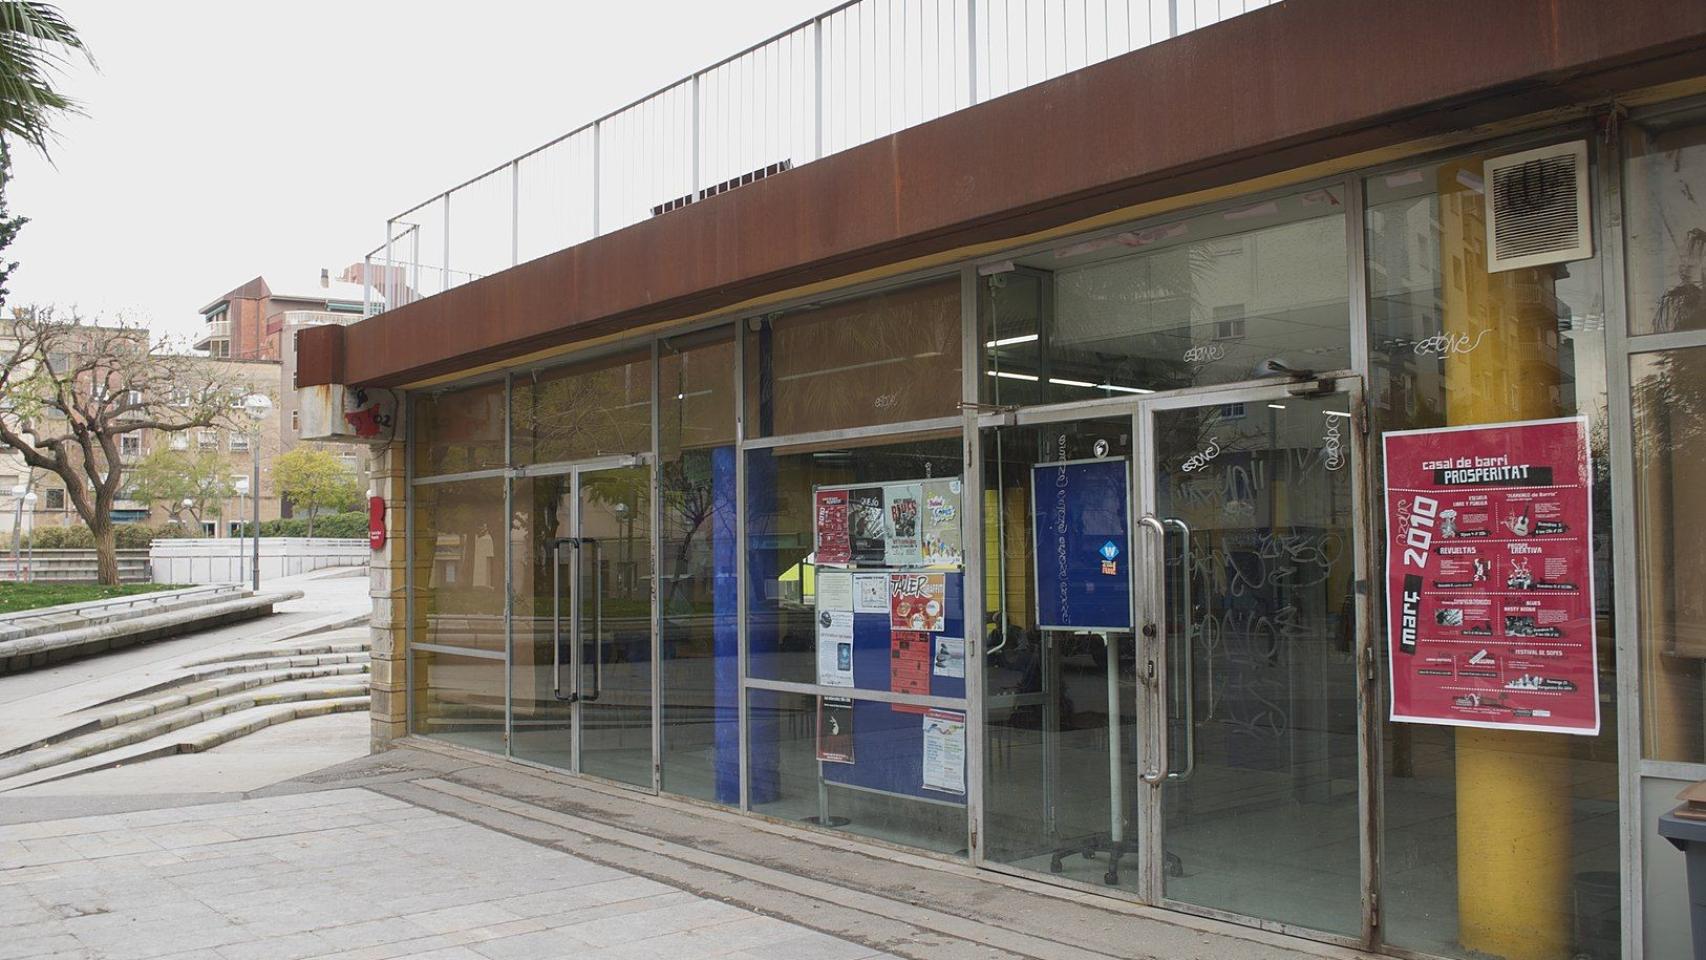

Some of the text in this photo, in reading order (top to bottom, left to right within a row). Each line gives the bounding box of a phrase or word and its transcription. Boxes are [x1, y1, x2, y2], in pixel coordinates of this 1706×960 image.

[1422, 454, 1509, 471] casal de barri
[1444, 465, 1530, 485] PROSPERITAT
[1404, 495, 1439, 569] 2010
[1104, 546, 1116, 557] W
[1440, 547, 1476, 555] REVUELTAS
[891, 574, 934, 599] TALLER
[1402, 590, 1421, 647] març
